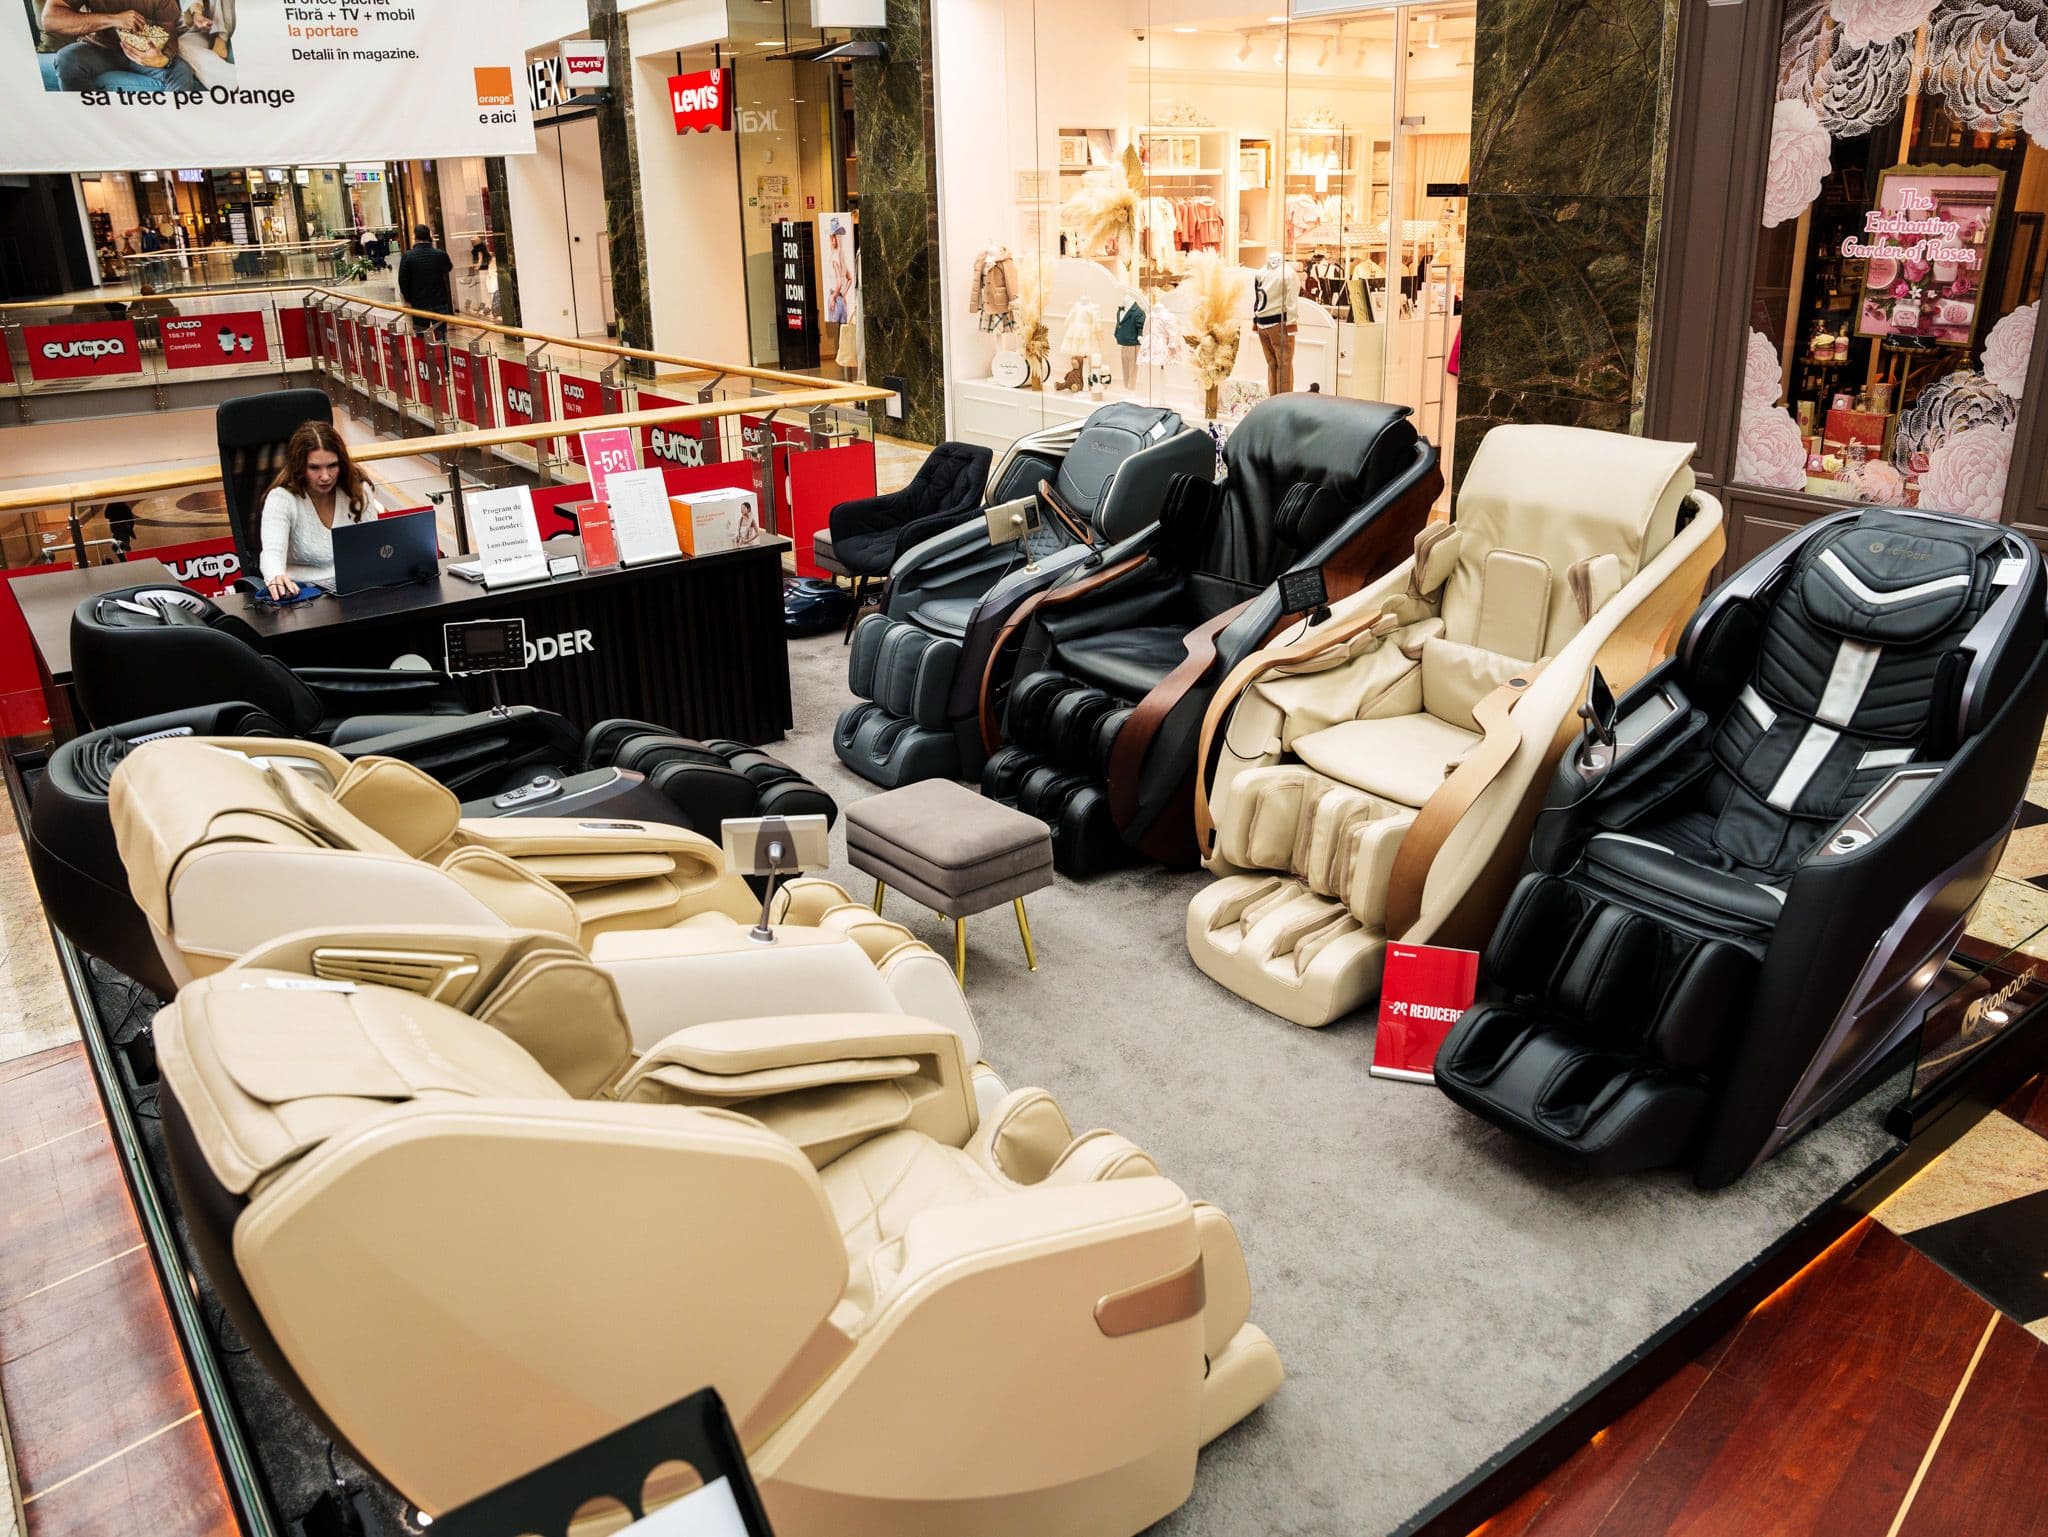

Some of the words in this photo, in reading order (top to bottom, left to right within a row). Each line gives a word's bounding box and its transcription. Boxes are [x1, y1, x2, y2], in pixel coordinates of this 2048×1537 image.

[285, 7, 323, 21] Fibră
[340, 8, 359, 21] TV
[376, 8, 415, 21] mobil
[288, 24, 301, 37] la
[305, 25, 358, 39] portare
[292, 48, 334, 61] Detalii
[337, 49, 350, 60] în
[353, 48, 419, 62] magazine.
[117, 87, 167, 105] trec
[174, 89, 203, 110] pe
[210, 85, 295, 108] Orange
[479, 95, 510, 105] orange
[479, 113, 489, 124] e
[491, 109, 517, 124] aici
[1900, 188, 1934, 211] The
[782, 221, 794, 238] FIT
[1864, 210, 1960, 242] Enchanting
[783, 242, 799, 259] FOR
[1841, 236, 1902, 258] Garden
[1902, 239, 1926, 263] of
[1926, 238, 1977, 263] Roses
[785, 263, 796, 280] AN
[785, 284, 804, 301] ICON
[42, 338, 125, 361] europa
[482, 505, 512, 515] Program
[202, 561, 219, 572] fm
